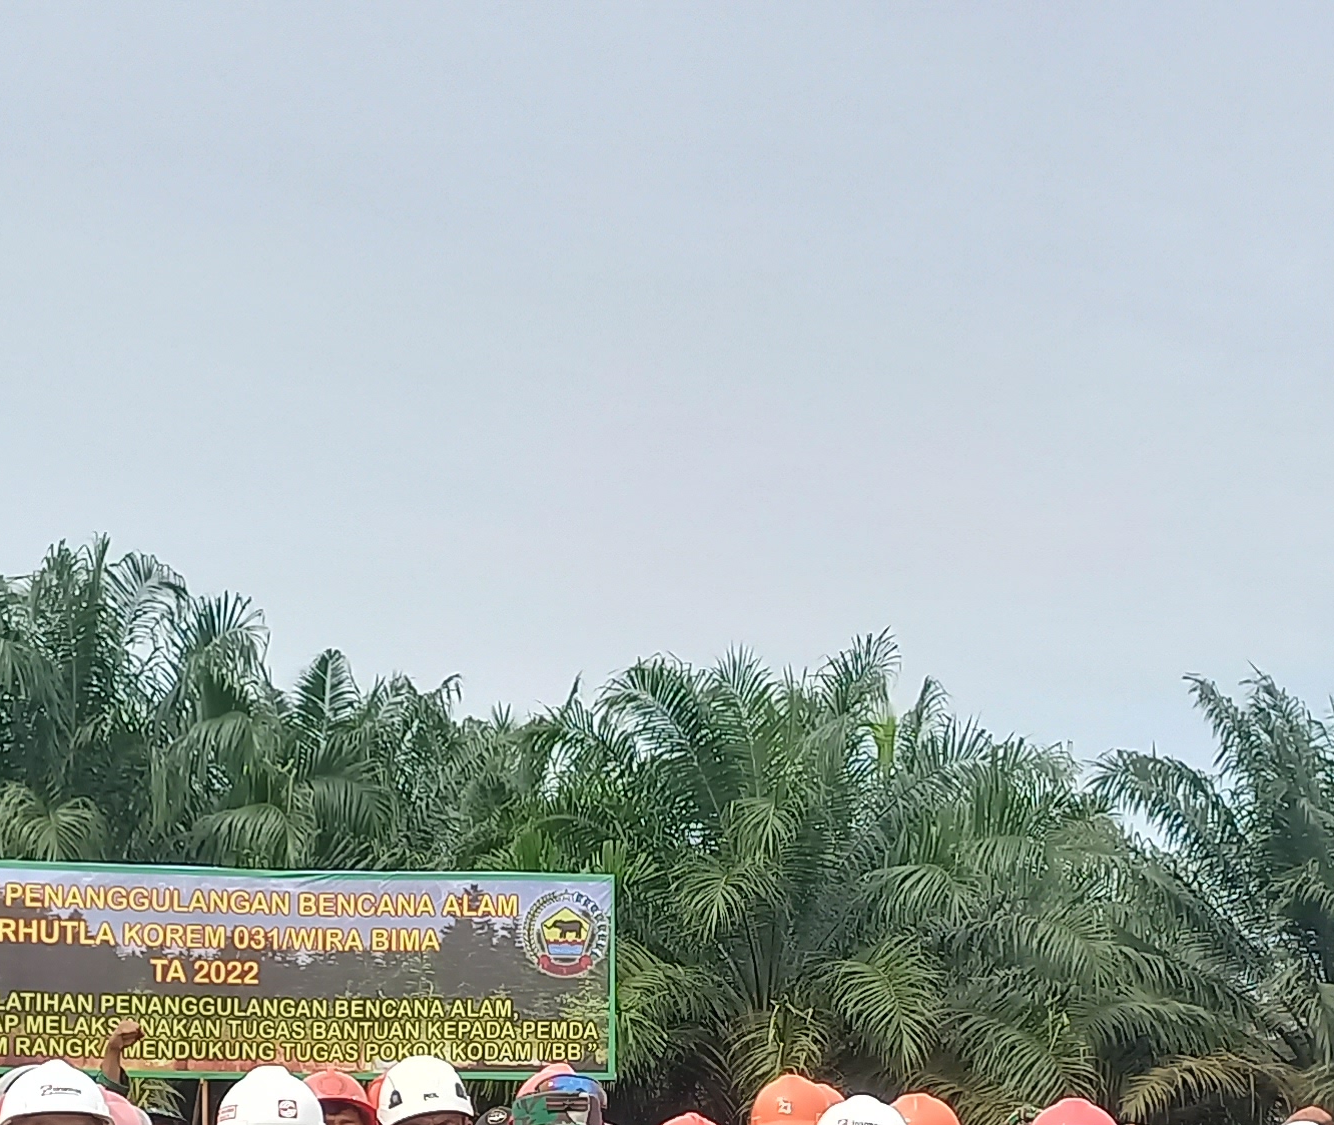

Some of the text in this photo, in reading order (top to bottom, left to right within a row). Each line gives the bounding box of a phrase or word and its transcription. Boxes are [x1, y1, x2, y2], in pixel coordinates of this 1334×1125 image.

[5, 882, 290, 916] PENANGGULANGAN
[298, 892, 435, 917] BENCANA
[441, 894, 519, 918] ALAM
[123, 922, 226, 950] KOREM
[234, 925, 364, 952] 031/WIRA
[371, 928, 441, 952] BIMA
[150, 959, 260, 985] TA 2022
[100, 995, 328, 1018] PENANGGULANGAN
[335, 1000, 445, 1019] BENCANA
[450, 1000, 519, 1021] ALAM,
[26, 1015, 221, 1038] MELAKSNAKAN
[228, 1019, 305, 1040] TUGAS
[312, 1021, 421, 1040] BANTUAN
[428, 1022, 516, 1040] KEPADA
[522, 1022, 599, 1040] PEMDA
[123, 1040, 275, 1061] MENDUKUNG
[281, 1042, 359, 1062] TUGAS
[366, 1043, 446, 1062] POKOK
[452, 1043, 531, 1061] KODAM
[537, 1043, 582, 1061] I/BB
